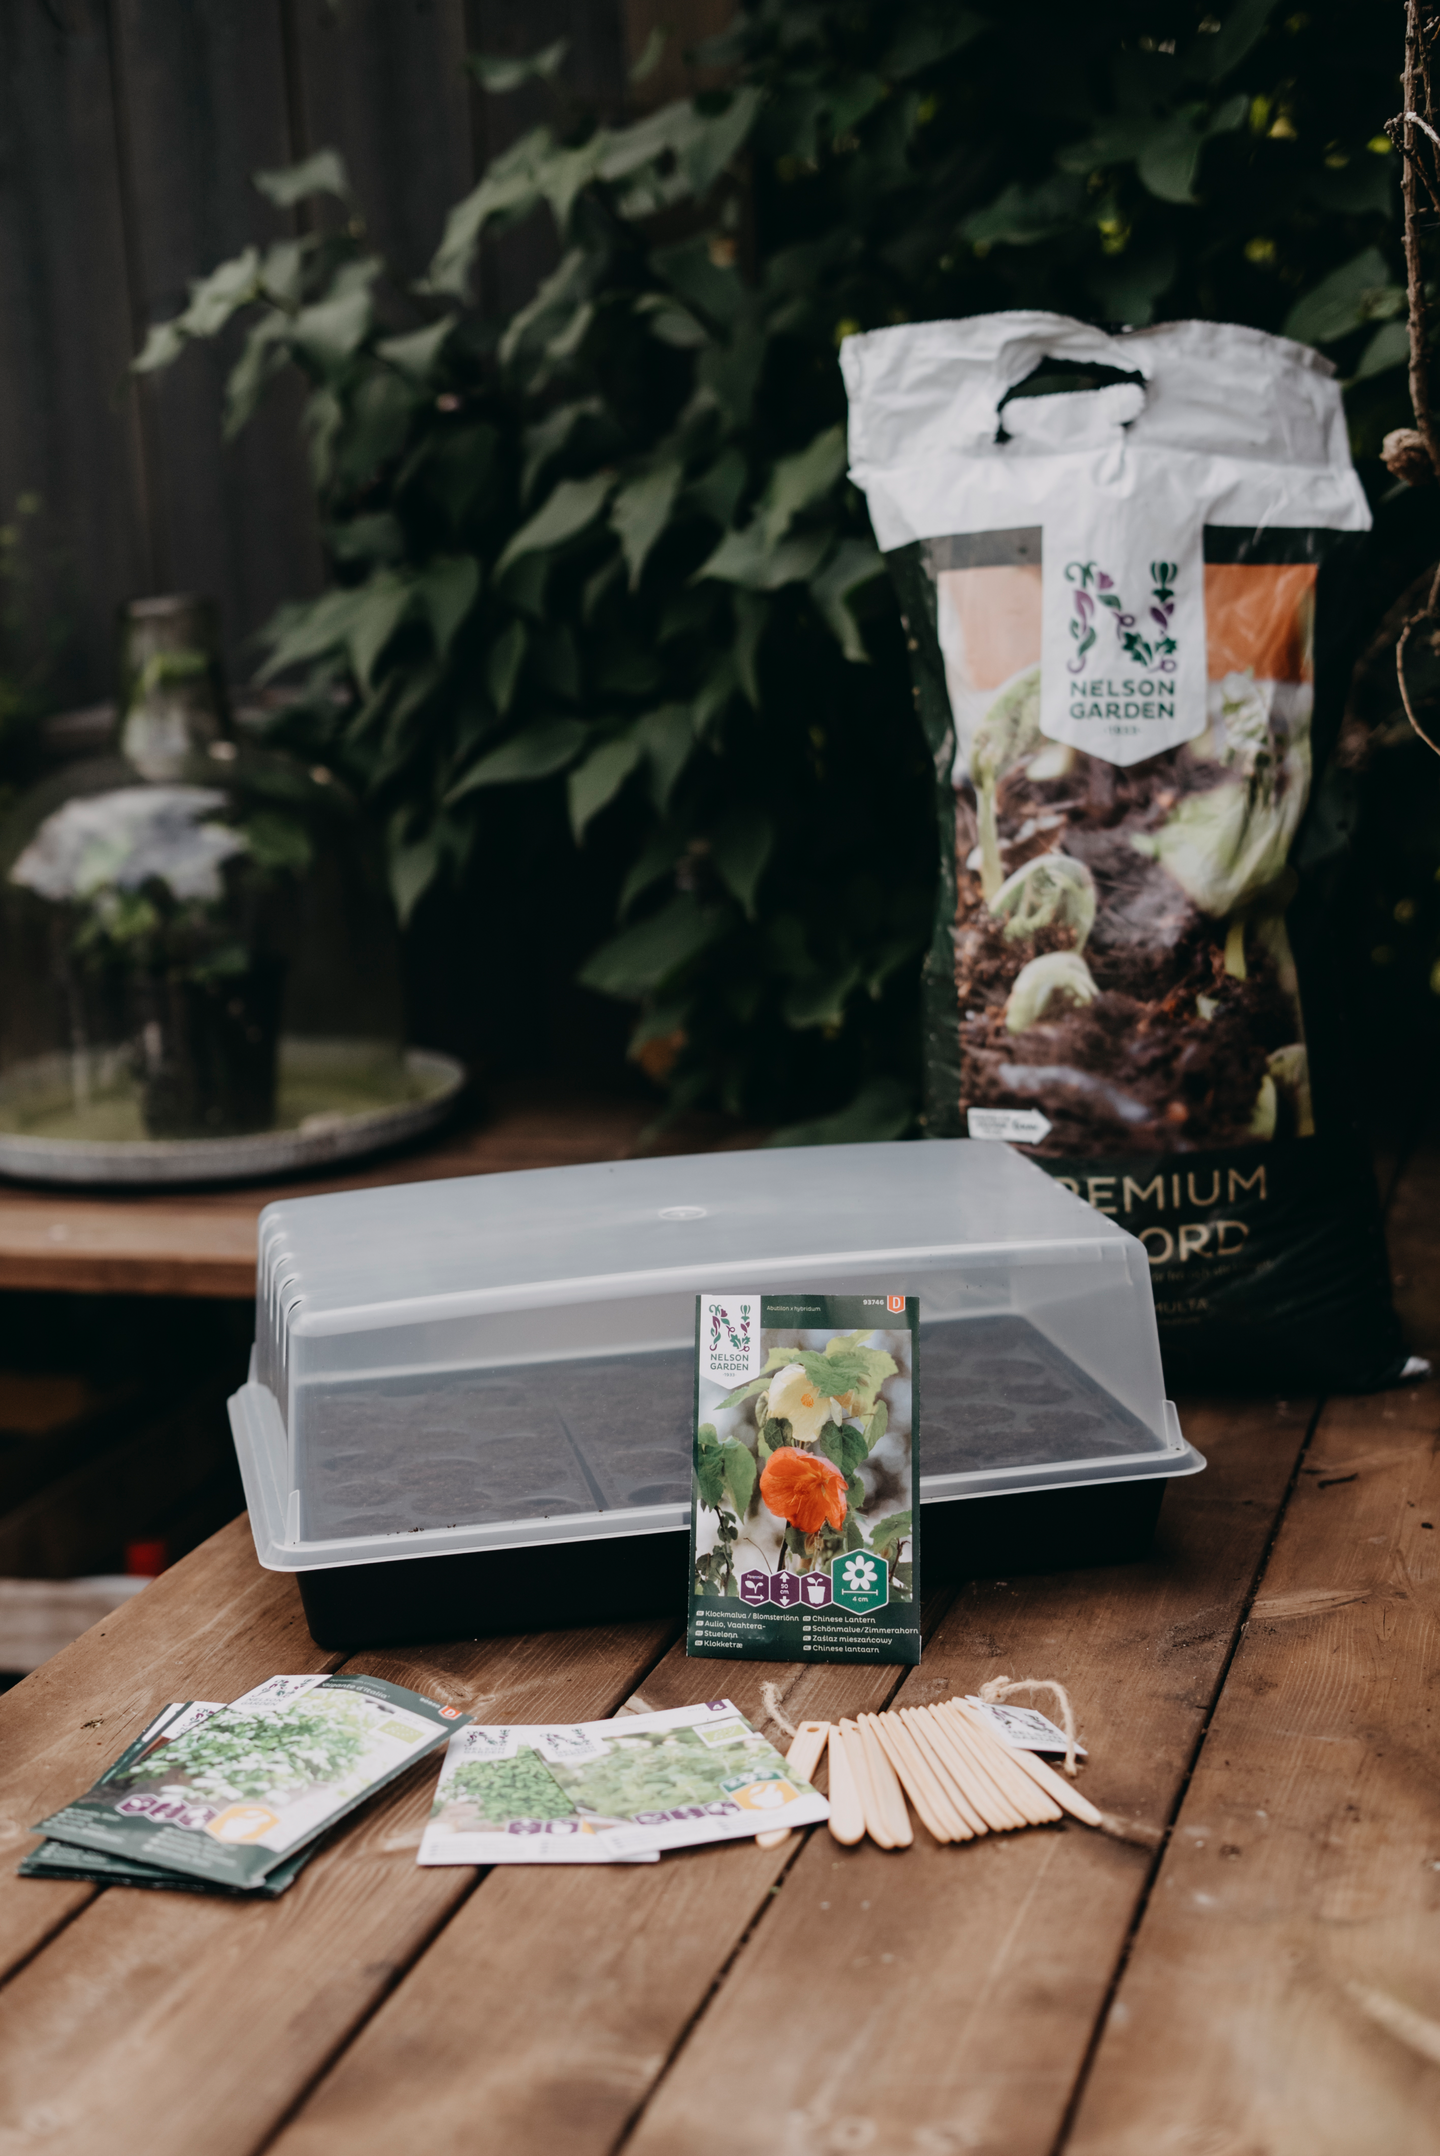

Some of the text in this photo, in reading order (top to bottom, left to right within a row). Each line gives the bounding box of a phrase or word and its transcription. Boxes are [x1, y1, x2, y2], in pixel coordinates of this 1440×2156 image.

[1070, 680, 1175, 697] NELSON
[1069, 702, 1175, 720] GARDEN
[1052, 1164, 1268, 1214] EMIUM
[892, 1296, 901, 1309] D
[710, 1353, 749, 1362] NELSON
[710, 1362, 749, 1371] GARDEN
[705, 1610, 747, 1619] Klockmalva
[752, 1612, 800, 1621] Blomsterlönn
[812, 1615, 843, 1623] Chinese
[844, 1616, 876, 1624] Lantern
[704, 1620, 726, 1628] Aulio,
[727, 1621, 766, 1630] Vaahtera-
[812, 1625, 919, 1634] Schönmalve/Zimmerahorn
[703, 1639, 743, 1649] Klokketræ
[812, 1634, 838, 1642] Zaślaz
[839, 1635, 893, 1645] mieszańcowy
[812, 1644, 844, 1652] Chinese
[844, 1645, 880, 1653] lantaarn
